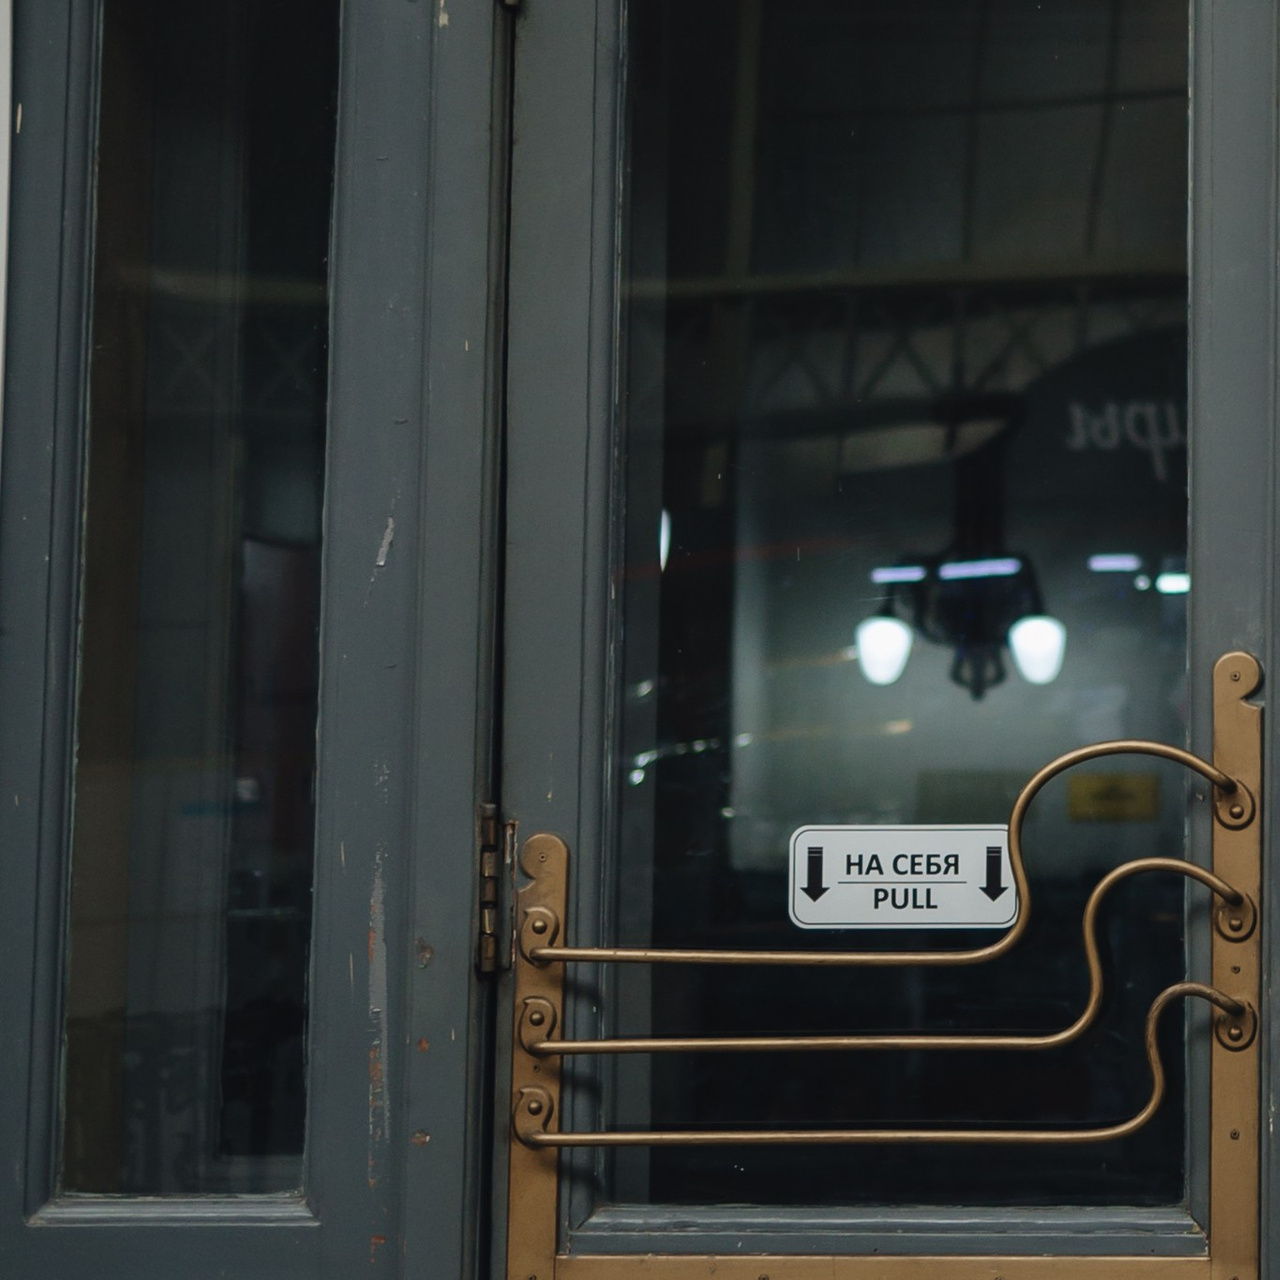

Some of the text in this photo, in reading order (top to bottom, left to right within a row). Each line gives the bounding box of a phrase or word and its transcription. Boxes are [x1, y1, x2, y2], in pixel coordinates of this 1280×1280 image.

[846, 853, 960, 876] НА СЕБЯ
[873, 887, 938, 910] PULL
